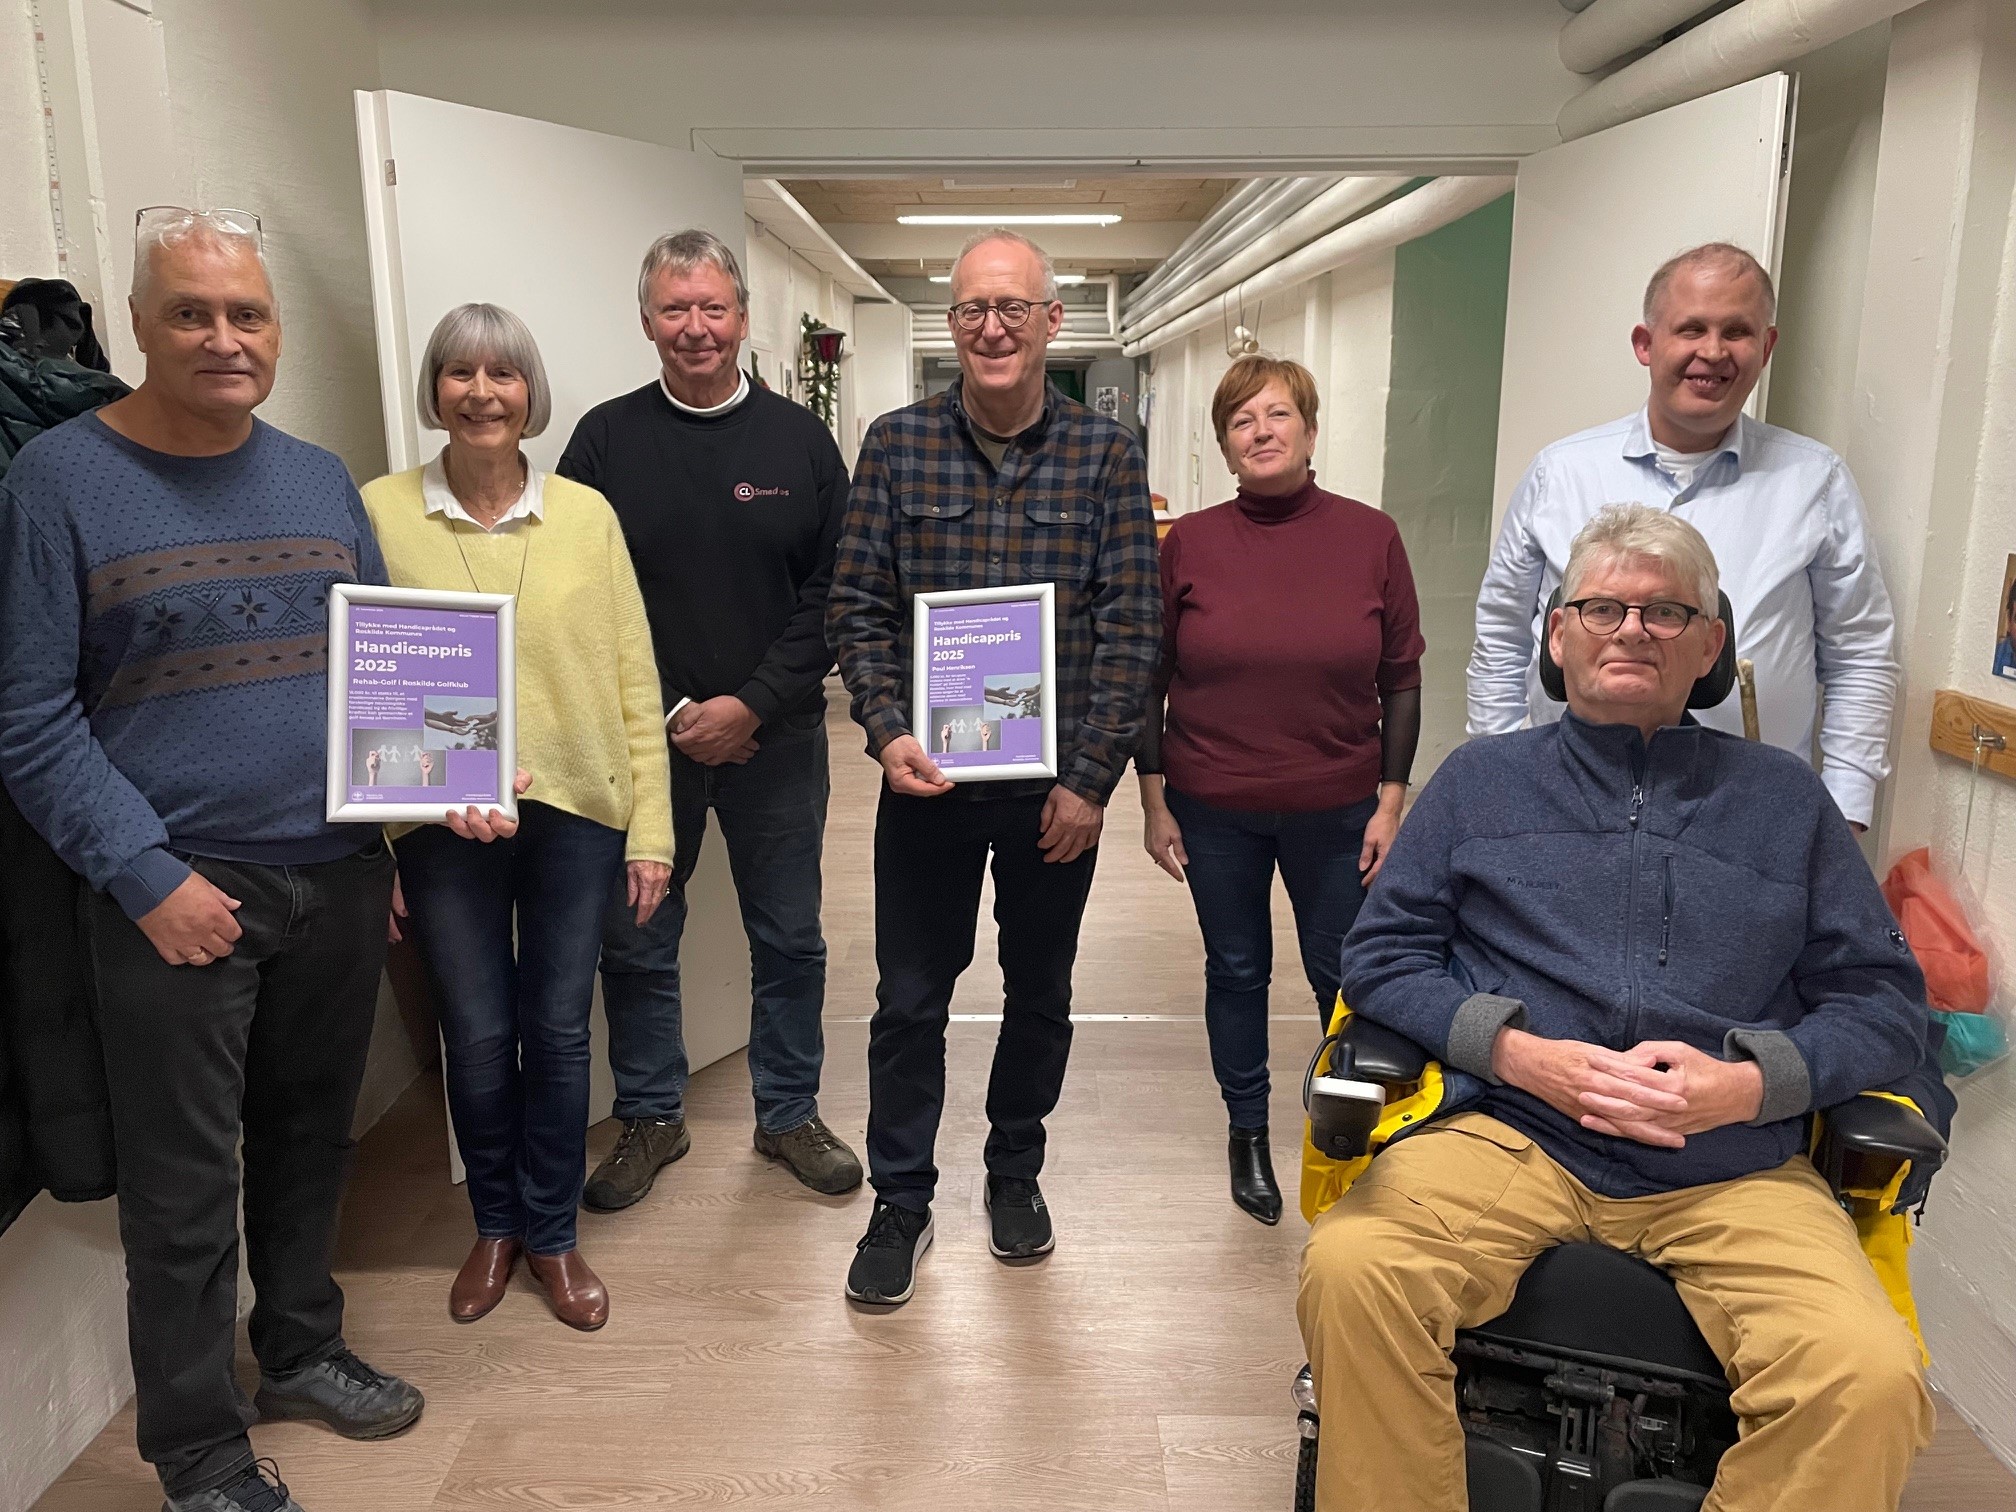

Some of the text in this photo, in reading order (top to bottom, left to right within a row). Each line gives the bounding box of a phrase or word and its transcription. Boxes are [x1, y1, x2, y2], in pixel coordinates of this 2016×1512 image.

[739, 487, 751, 496] CL
[355, 621, 382, 629] Tillykke
[398, 624, 446, 633] Handicaprådet
[385, 629, 422, 637] Kommunes
[933, 629, 1021, 647] Handicappris
[355, 640, 472, 659] Handicappris
[933, 649, 965, 661] 2025
[354, 658, 397, 672] 2025
[353, 678, 397, 686] Rehab-Golf
[402, 679, 435, 687] Roskilde
